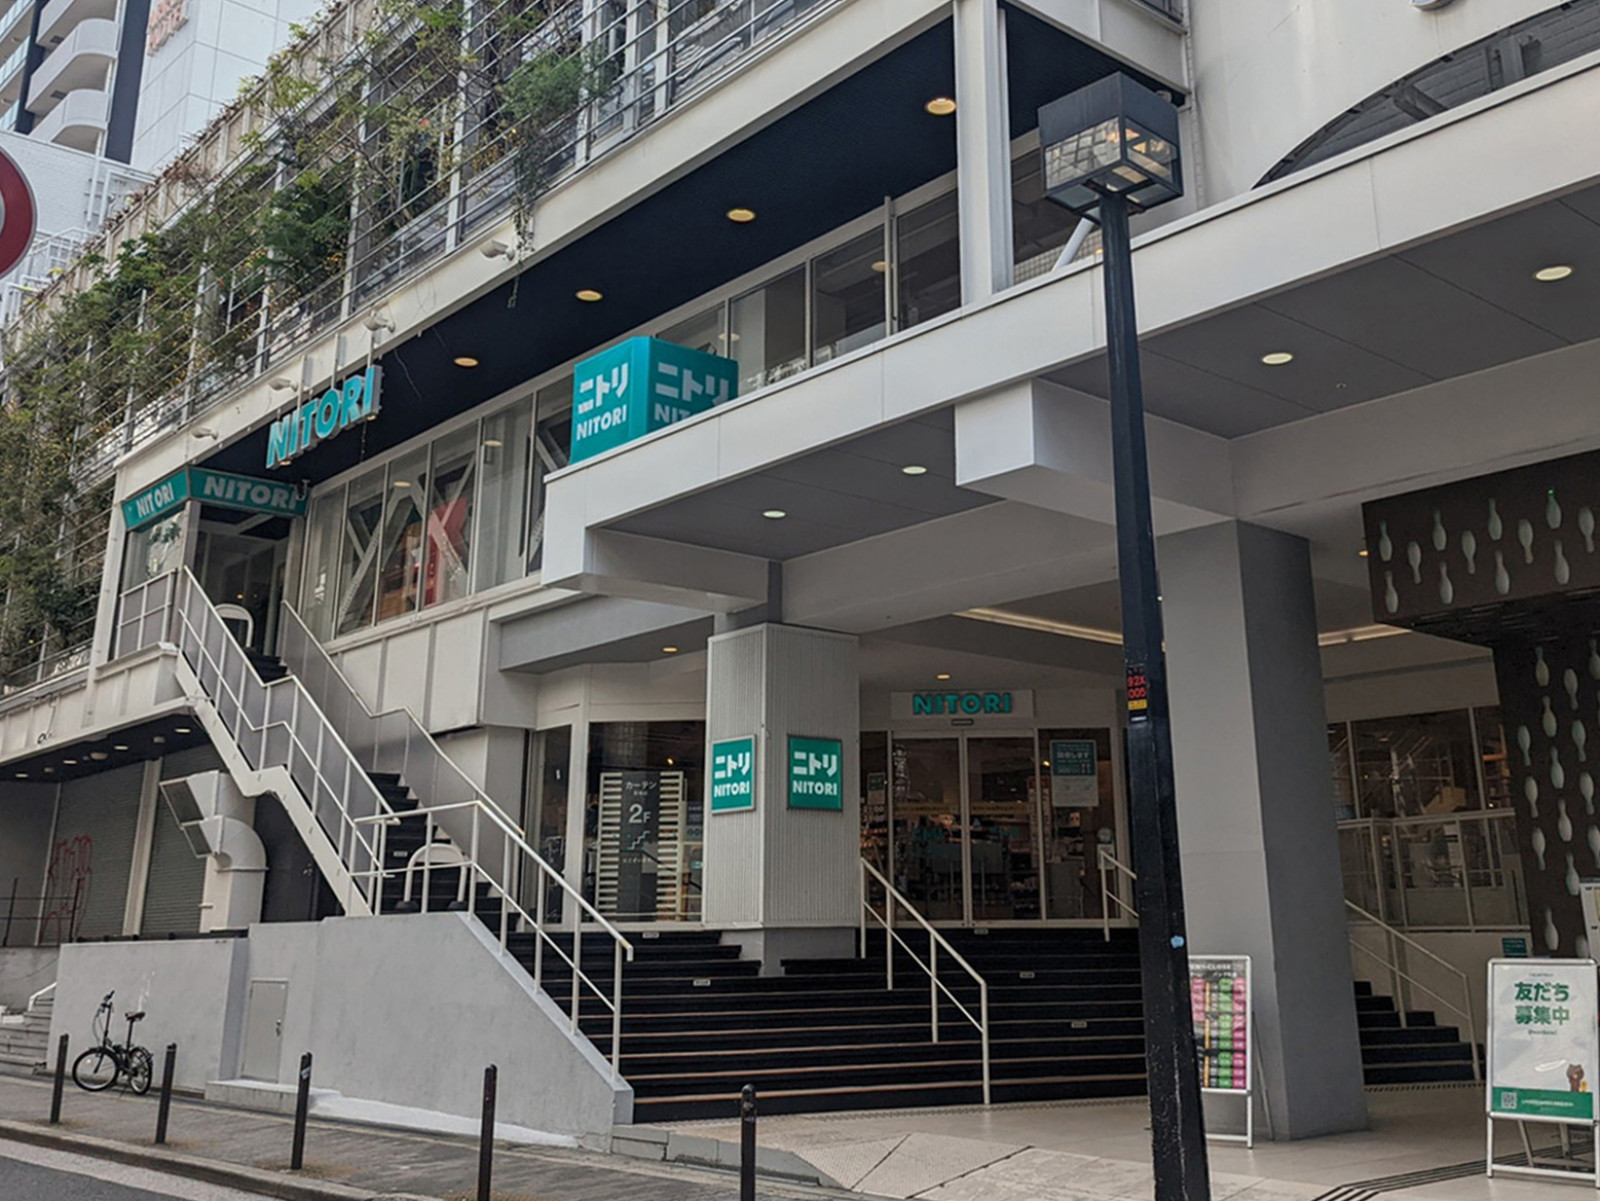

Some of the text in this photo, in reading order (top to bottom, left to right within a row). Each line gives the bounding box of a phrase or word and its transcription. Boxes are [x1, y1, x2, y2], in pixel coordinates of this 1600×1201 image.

[577, 362, 629, 415] ニトリ
[655, 361, 729, 405] ニトリ
[265, 366, 379, 470] NITORI
[575, 404, 627, 441] NITORI
[135, 481, 175, 518] NITORI
[203, 475, 297, 511] NITORI
[912, 692, 1012, 715] NITORI
[714, 751, 750, 779] ニトリ
[793, 751, 837, 777] ニトリ
[714, 781, 750, 798] NITORI
[792, 780, 838, 796] NITORI
[628, 803, 652, 824] 2F
[1514, 981, 1570, 1002] 友だち
[1514, 1005, 1570, 1026] 募集中
